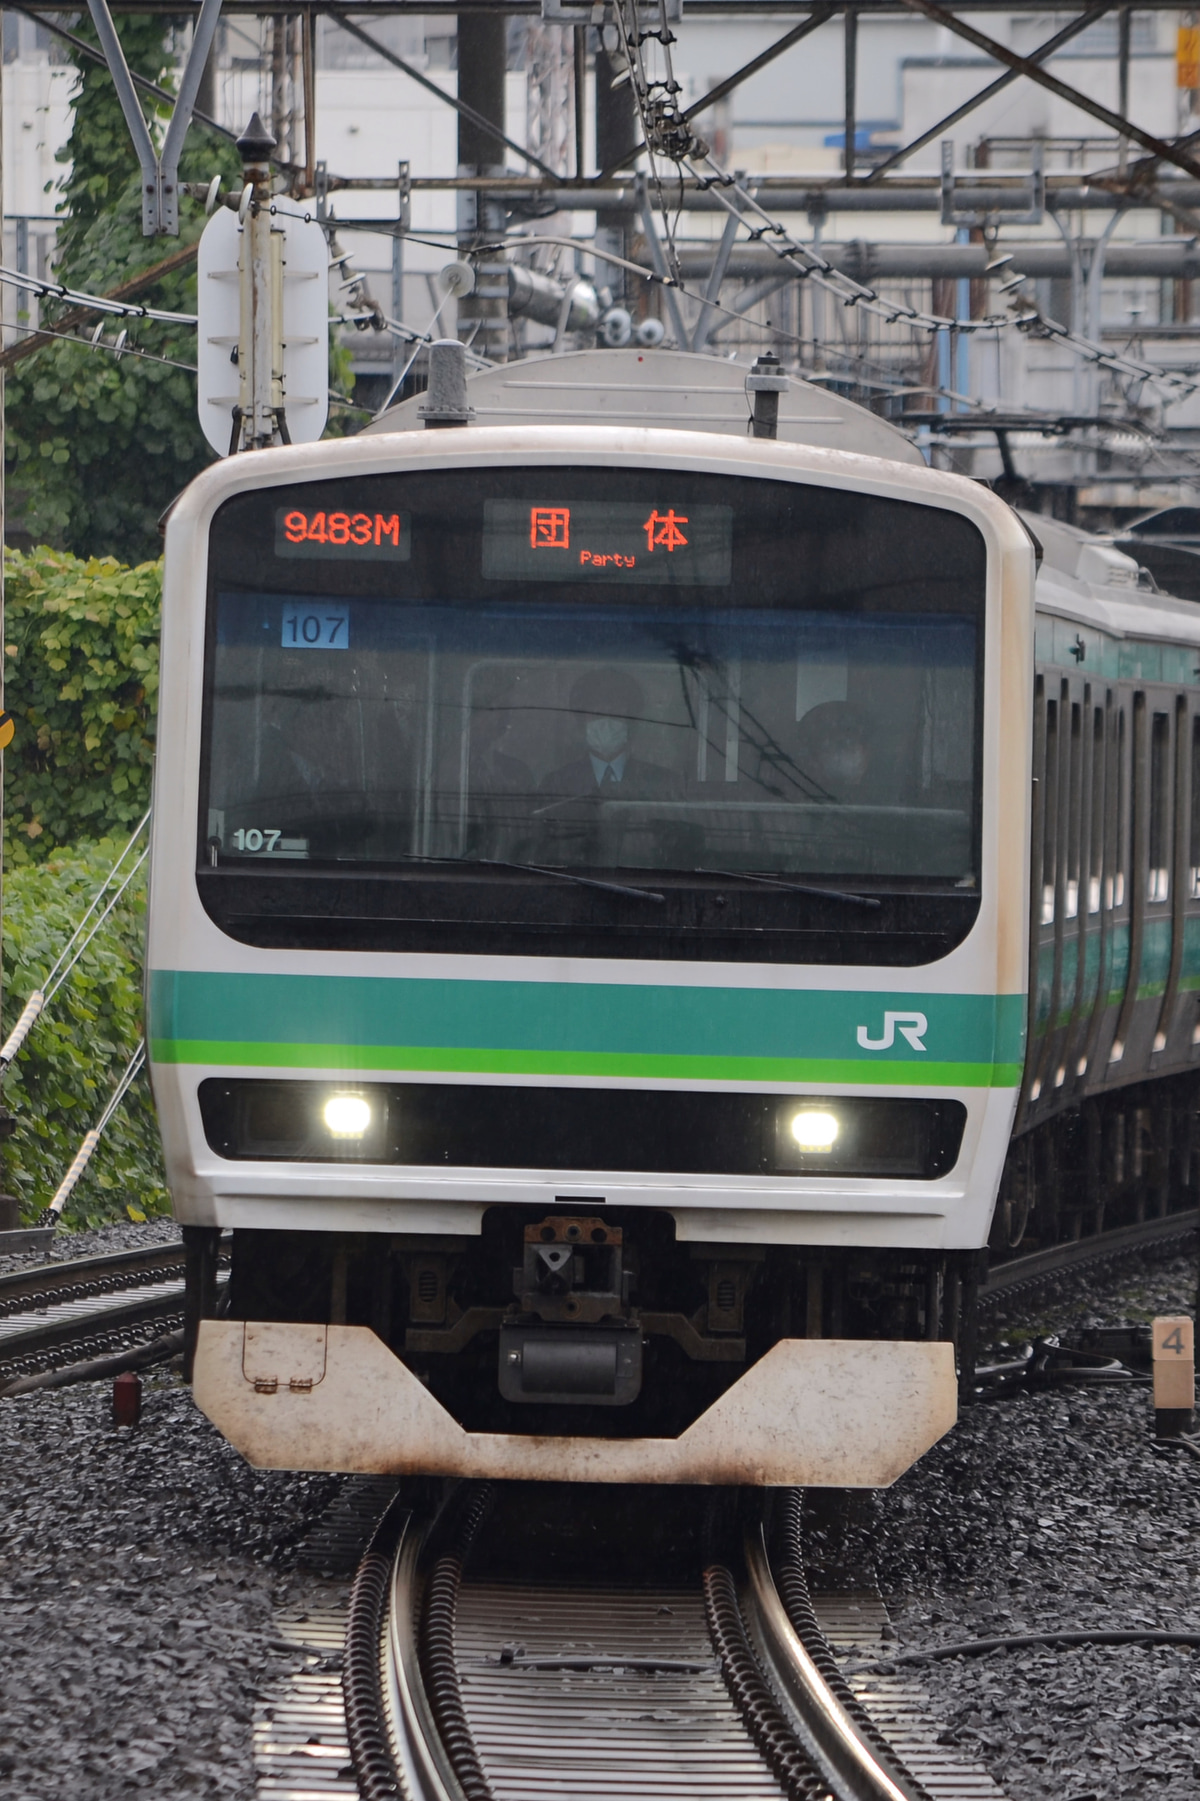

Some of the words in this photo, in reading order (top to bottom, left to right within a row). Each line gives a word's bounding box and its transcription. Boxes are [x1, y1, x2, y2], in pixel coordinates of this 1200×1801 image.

[284, 511, 400, 546] 9483M
[580, 550, 636, 568] Party
[286, 615, 345, 643] 107
[233, 828, 282, 852] 107
[856, 1011, 928, 1052] JR
[1161, 1327, 1185, 1355] 4
